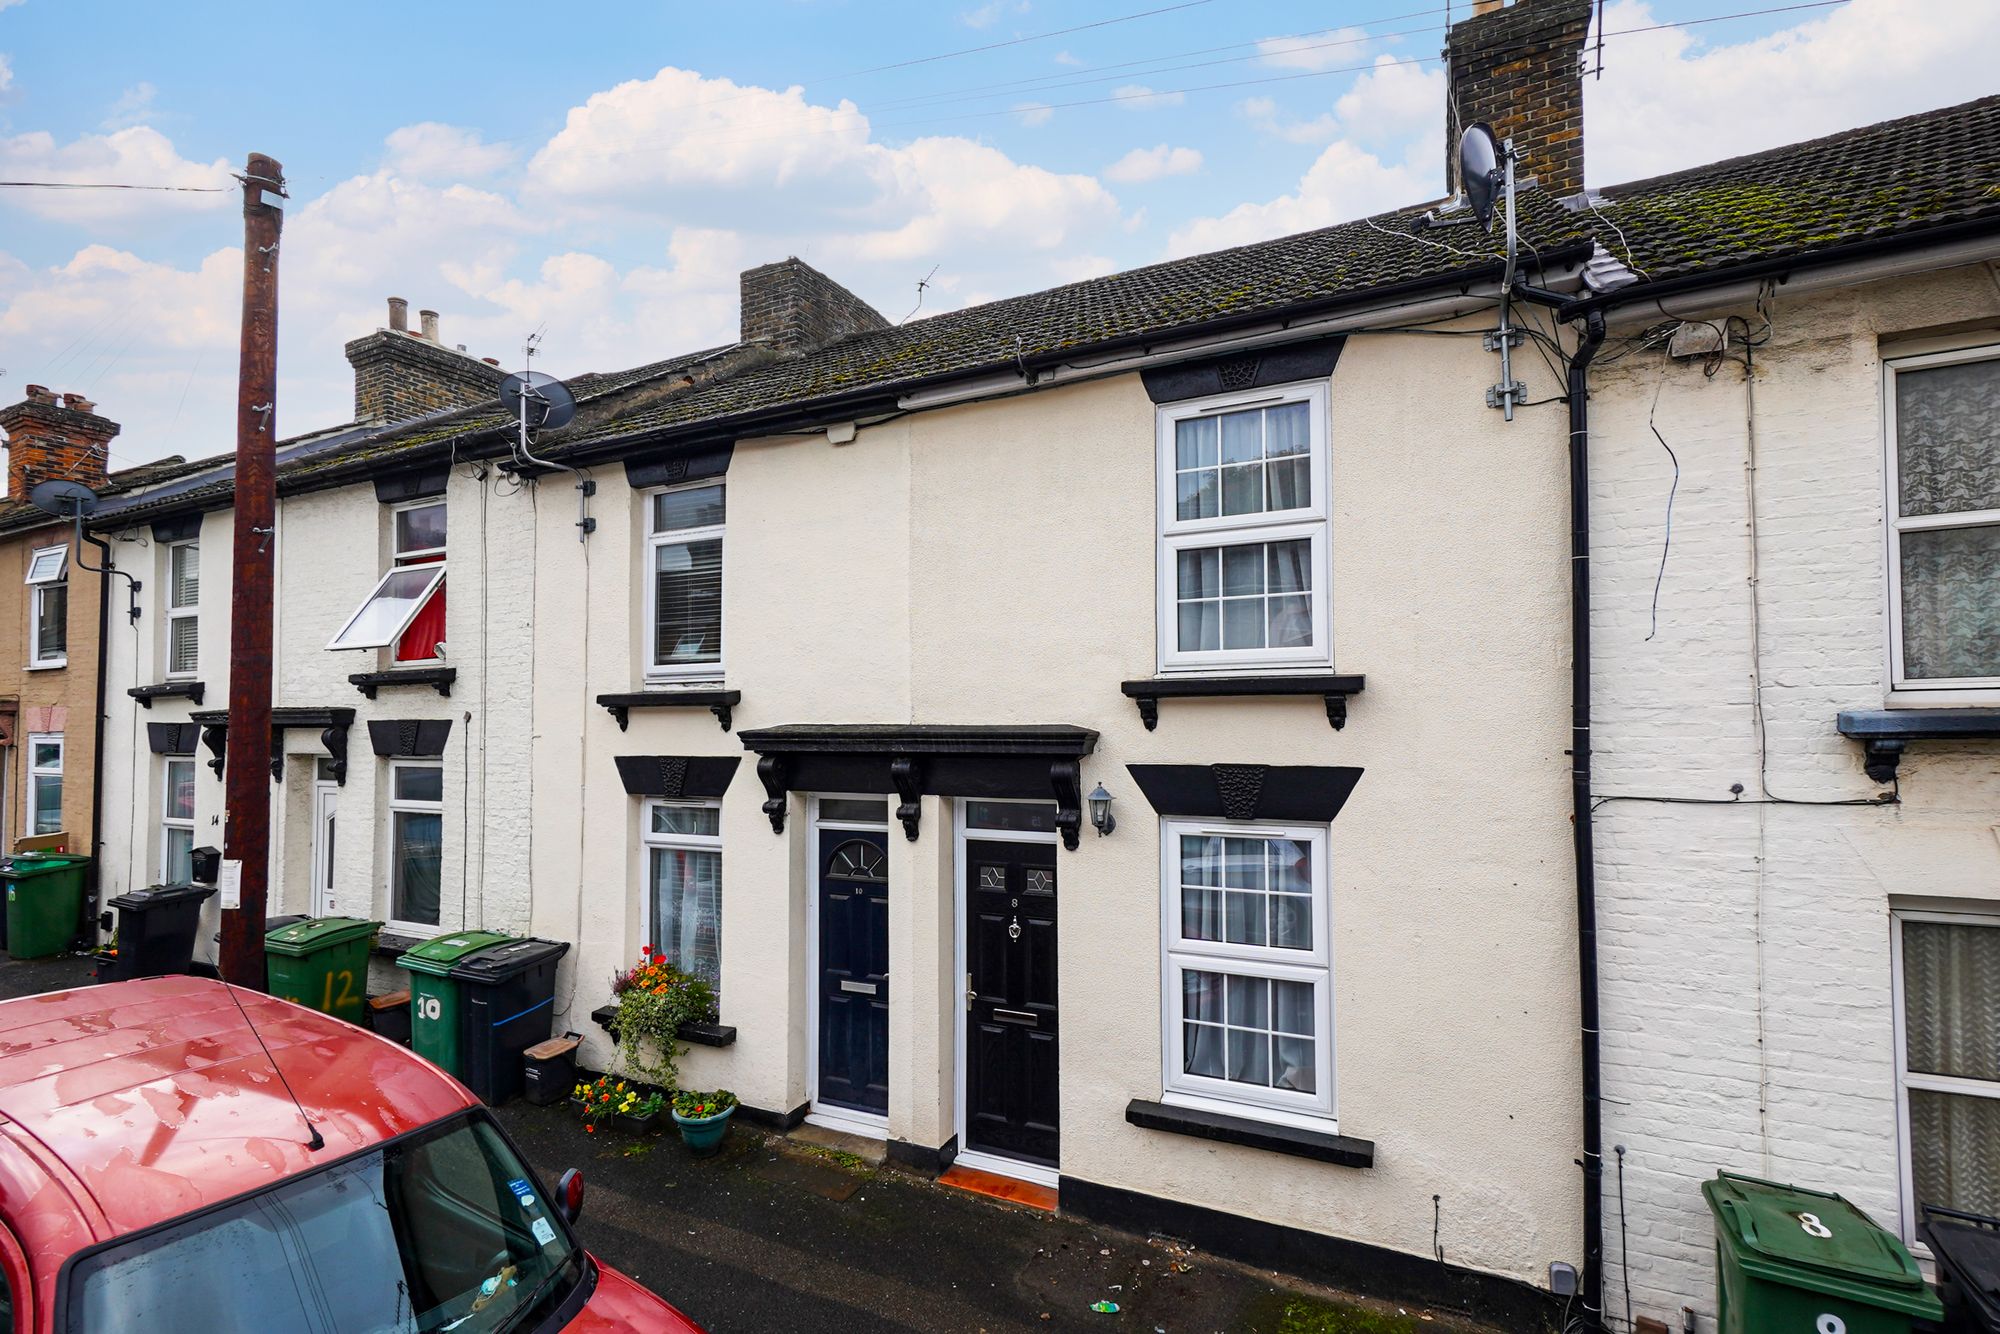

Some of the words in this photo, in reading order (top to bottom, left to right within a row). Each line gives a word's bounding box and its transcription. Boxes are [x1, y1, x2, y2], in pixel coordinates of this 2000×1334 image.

[211, 814, 219, 826] 14
[855, 887, 863, 895] 10
[1011, 898, 1019, 908] 8
[322, 970, 359, 1011] 12
[417, 996, 441, 1020] 10
[1798, 1212, 1833, 1238] 8
